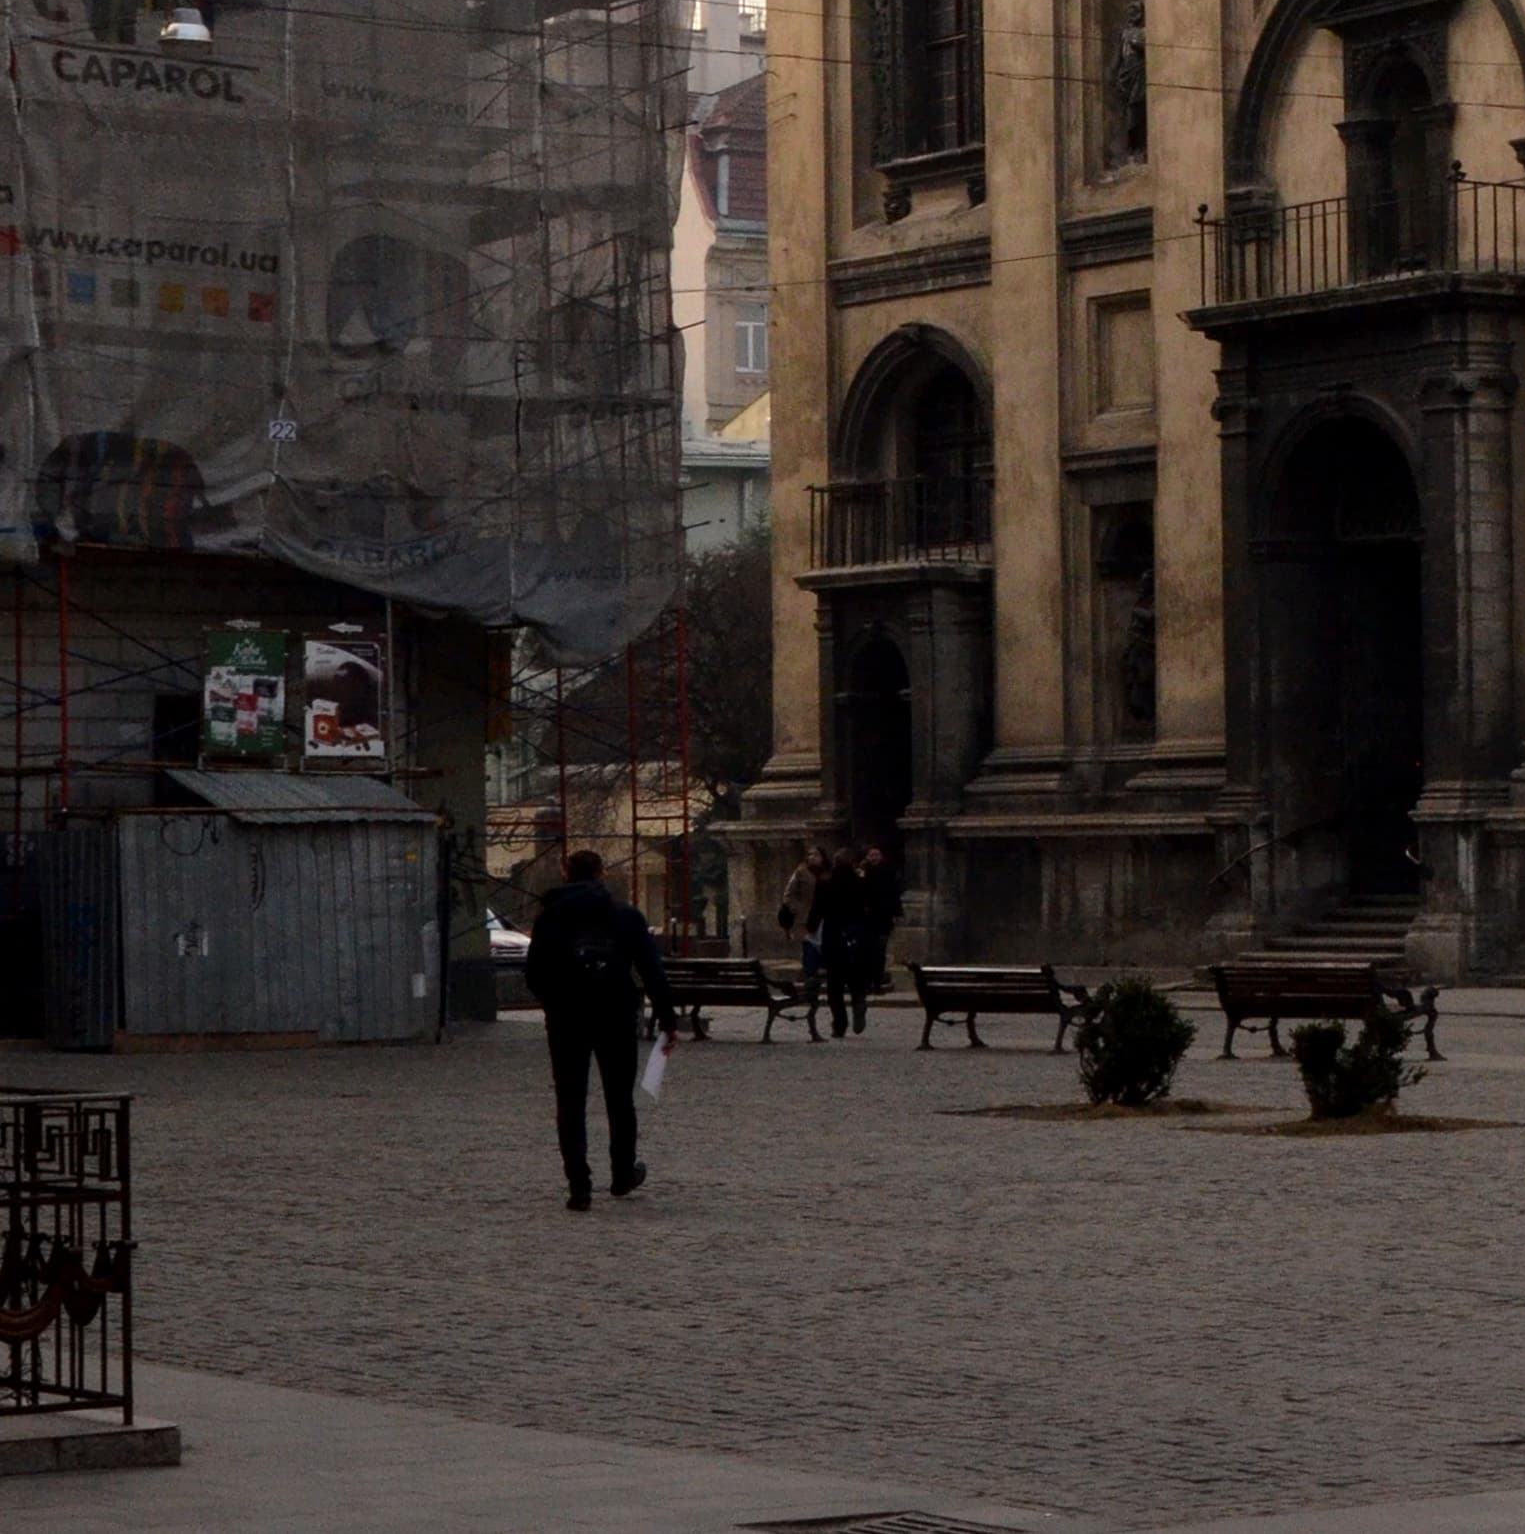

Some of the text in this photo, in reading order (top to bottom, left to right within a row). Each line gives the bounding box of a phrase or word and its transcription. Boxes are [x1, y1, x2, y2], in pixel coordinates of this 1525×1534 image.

[52, 50, 243, 102] CAPAROL
[27, 226, 279, 274] www.caparol.ua
[271, 424, 295, 438] 22
